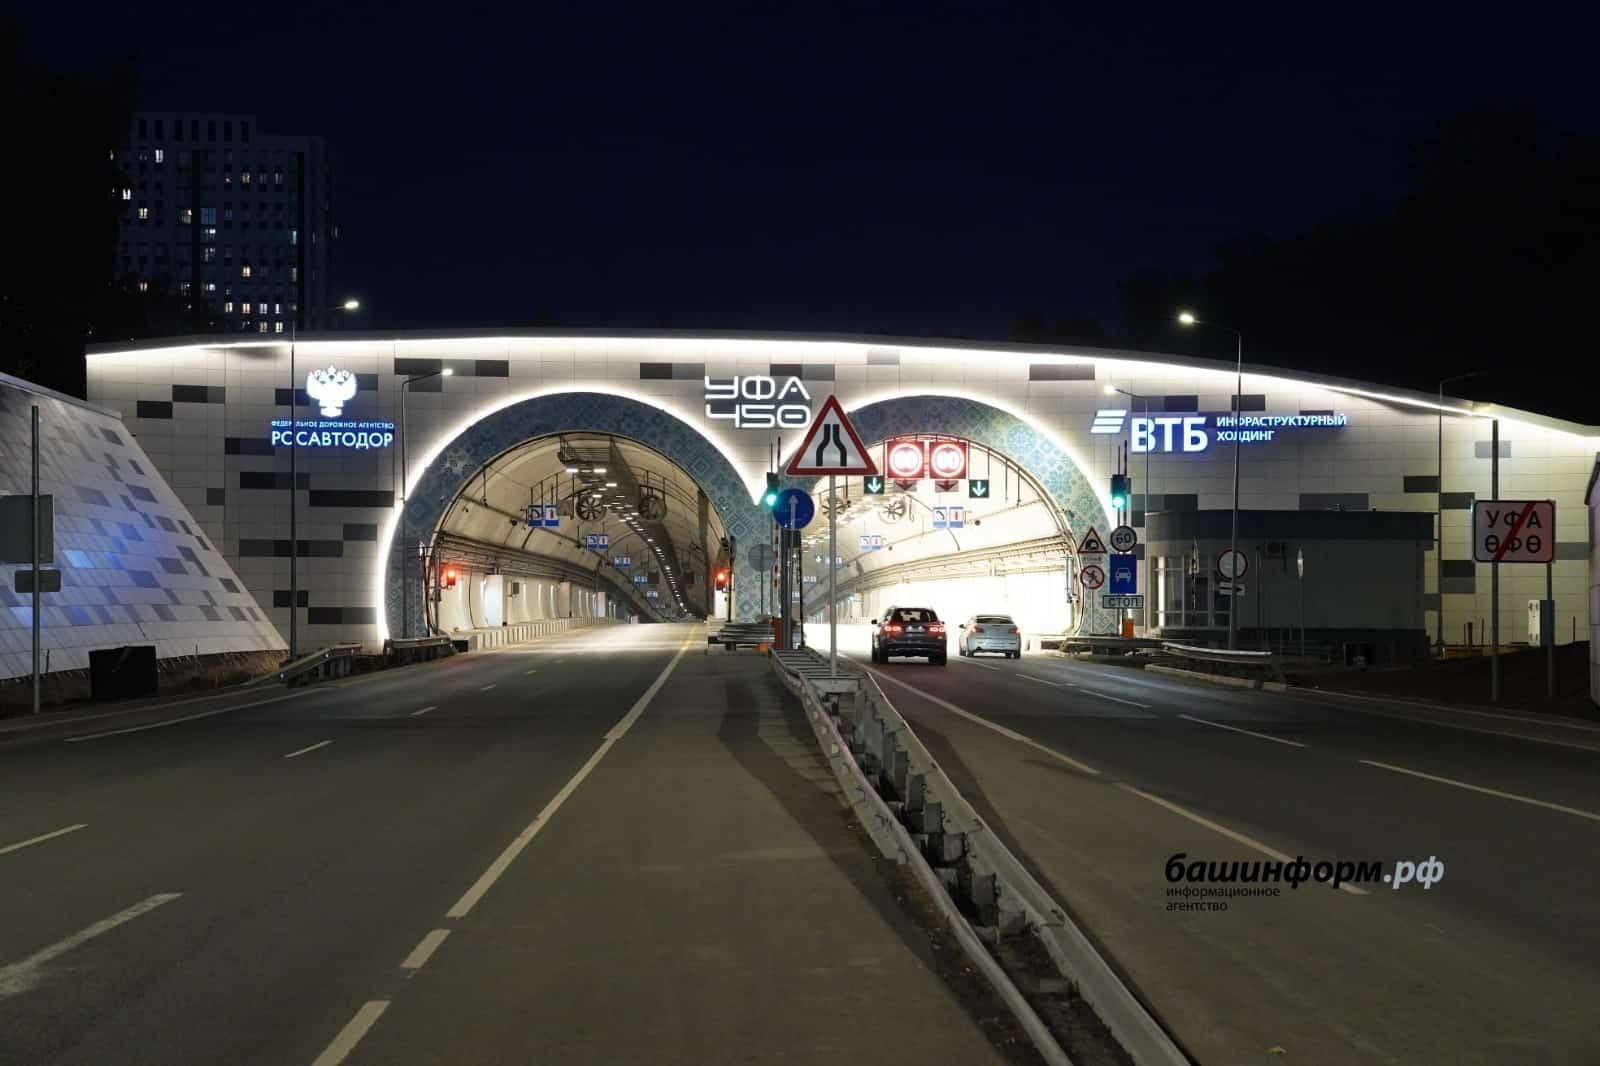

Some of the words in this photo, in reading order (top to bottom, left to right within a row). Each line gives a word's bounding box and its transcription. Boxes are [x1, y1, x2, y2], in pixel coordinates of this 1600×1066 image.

[704, 375, 811, 400] УФА
[705, 404, 811, 428] 450
[1216, 413, 1347, 427] ИНФРАСТРУКТУРНЫЙ
[358, 422, 394, 430] АГЕНТСТВО
[1131, 417, 1208, 452] ВТБ
[1216, 431, 1274, 442] ХОЛДИНГ
[1486, 510, 1542, 528] УФА
[1116, 532, 1131, 544] 60
[1108, 598, 1138, 607] СТОП
